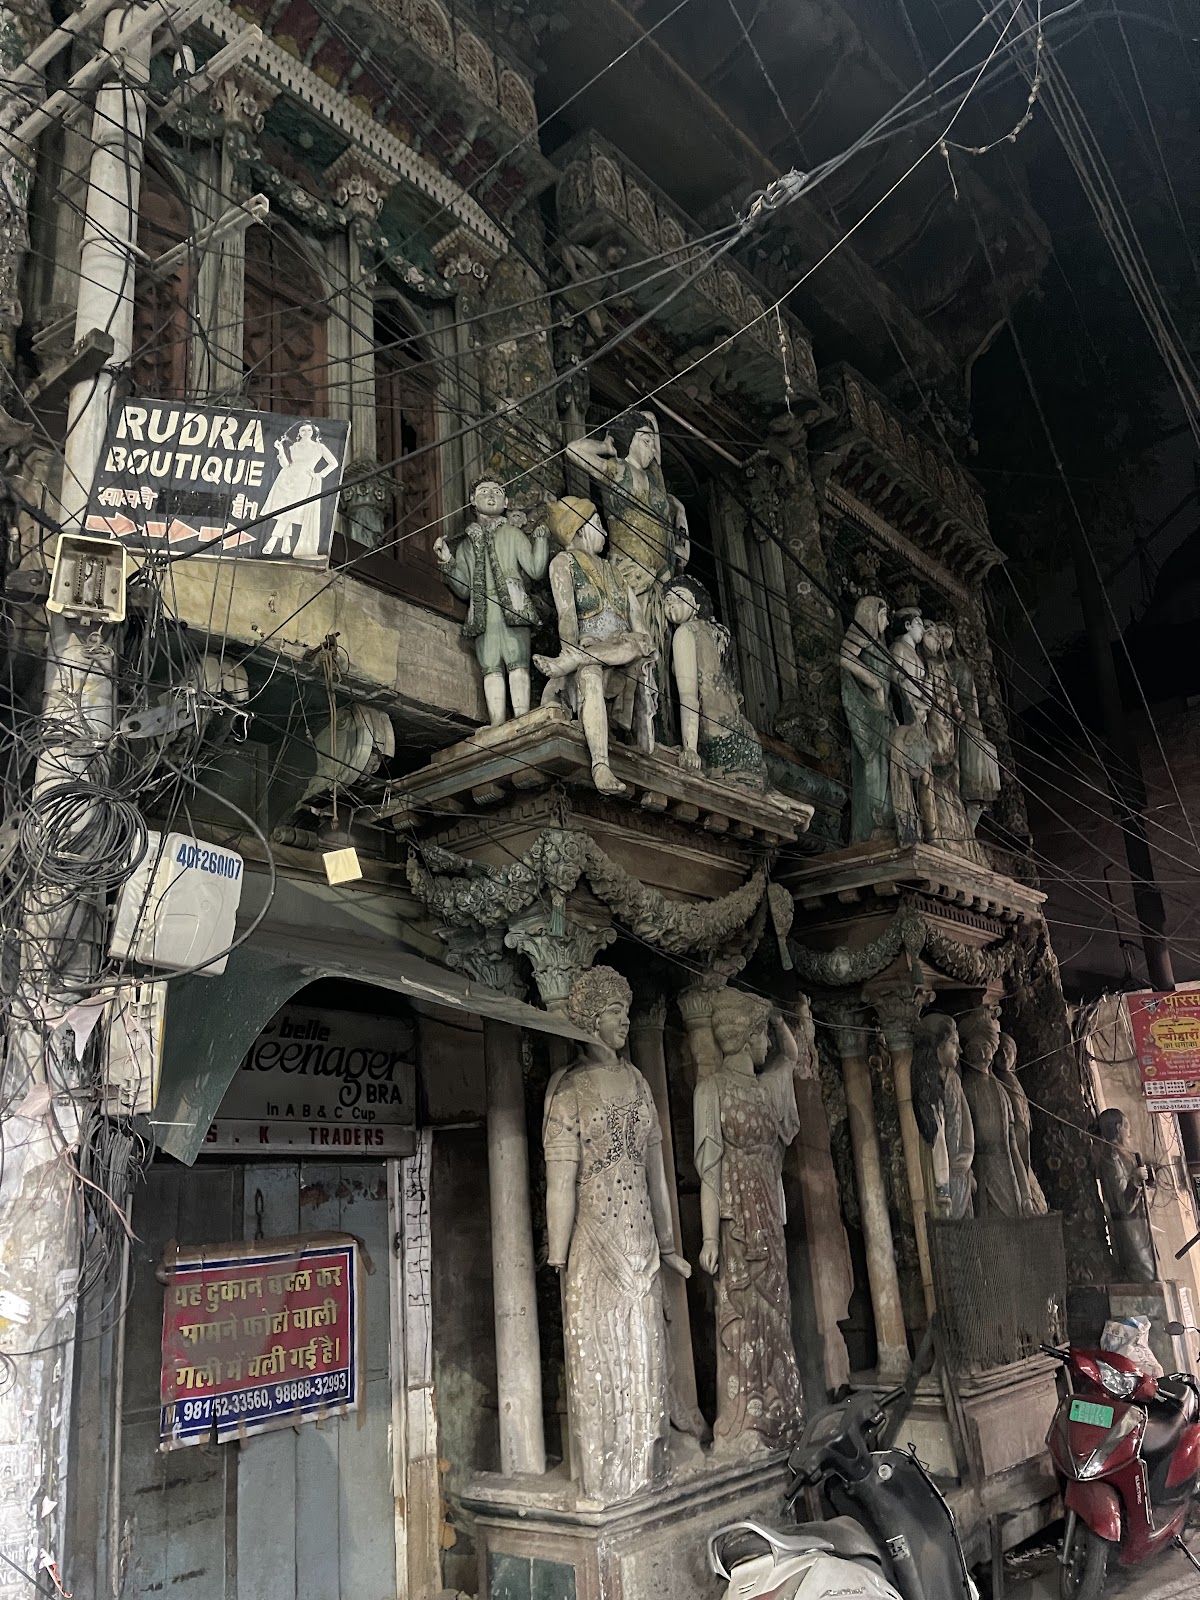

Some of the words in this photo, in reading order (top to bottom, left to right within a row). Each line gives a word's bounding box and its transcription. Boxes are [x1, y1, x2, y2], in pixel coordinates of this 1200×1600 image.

[115, 406, 265, 454] RUDRA
[104, 446, 265, 487] BOUTIQUE
[279, 1016, 331, 1042] belle
[366, 1083, 402, 1105] BRA
[266, 1102, 279, 1116] In
[286, 1103, 295, 1117] A
[302, 1105, 311, 1118] B
[317, 1105, 327, 1118] &
[334, 1106, 343, 1119] C
[352, 1106, 376, 1122] Cup
[308, 1126, 385, 1146] TRADERS
[175, 1283, 203, 1308] यह
[206, 1277, 263, 1313] दुकान
[267, 1269, 313, 1295] बदल
[315, 1266, 342, 1288] कर
[292, 1297, 338, 1330] वाली
[176, 1356, 222, 1389] गली
[227, 1352, 246, 1381] में
[248, 1344, 287, 1378] चली
[290, 1336, 318, 1371] गई
[275, 1373, 347, 1404] 98888-32993
